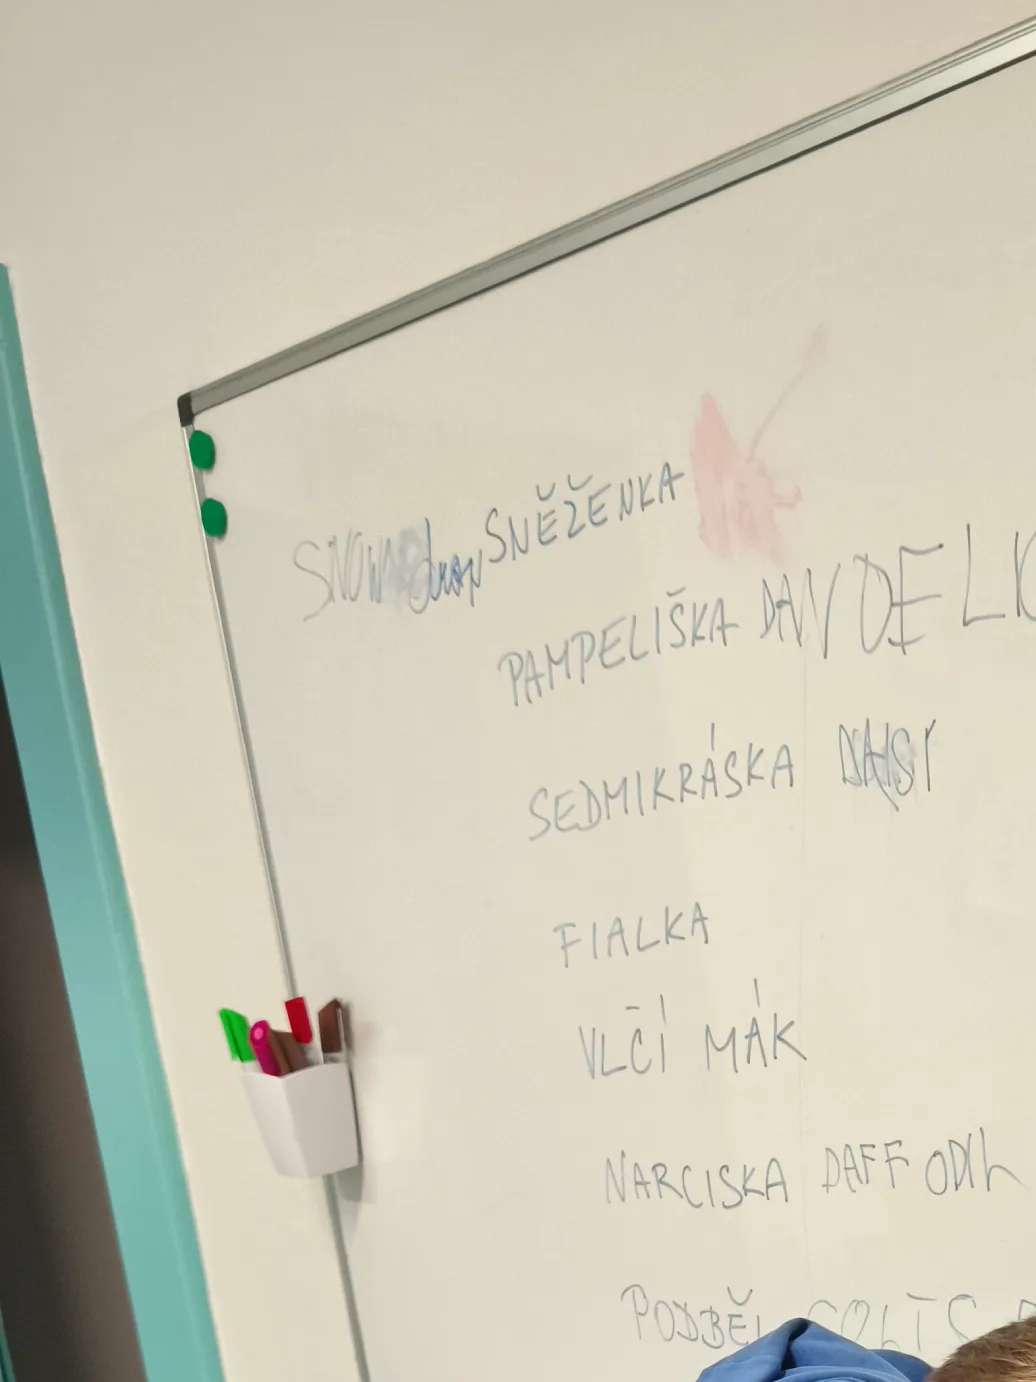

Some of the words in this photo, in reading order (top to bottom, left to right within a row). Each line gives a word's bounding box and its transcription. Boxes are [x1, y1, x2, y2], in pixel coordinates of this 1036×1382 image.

[485, 462, 685, 563] SNĚŽENKA
[497, 587, 739, 706] PAMPELIŠKA
[529, 722, 794, 841] SEDMIKRÁSKA
[553, 902, 709, 968] FIALKA
[704, 978, 807, 1073] MÁK
[605, 1150, 789, 1209] NARCISKA
